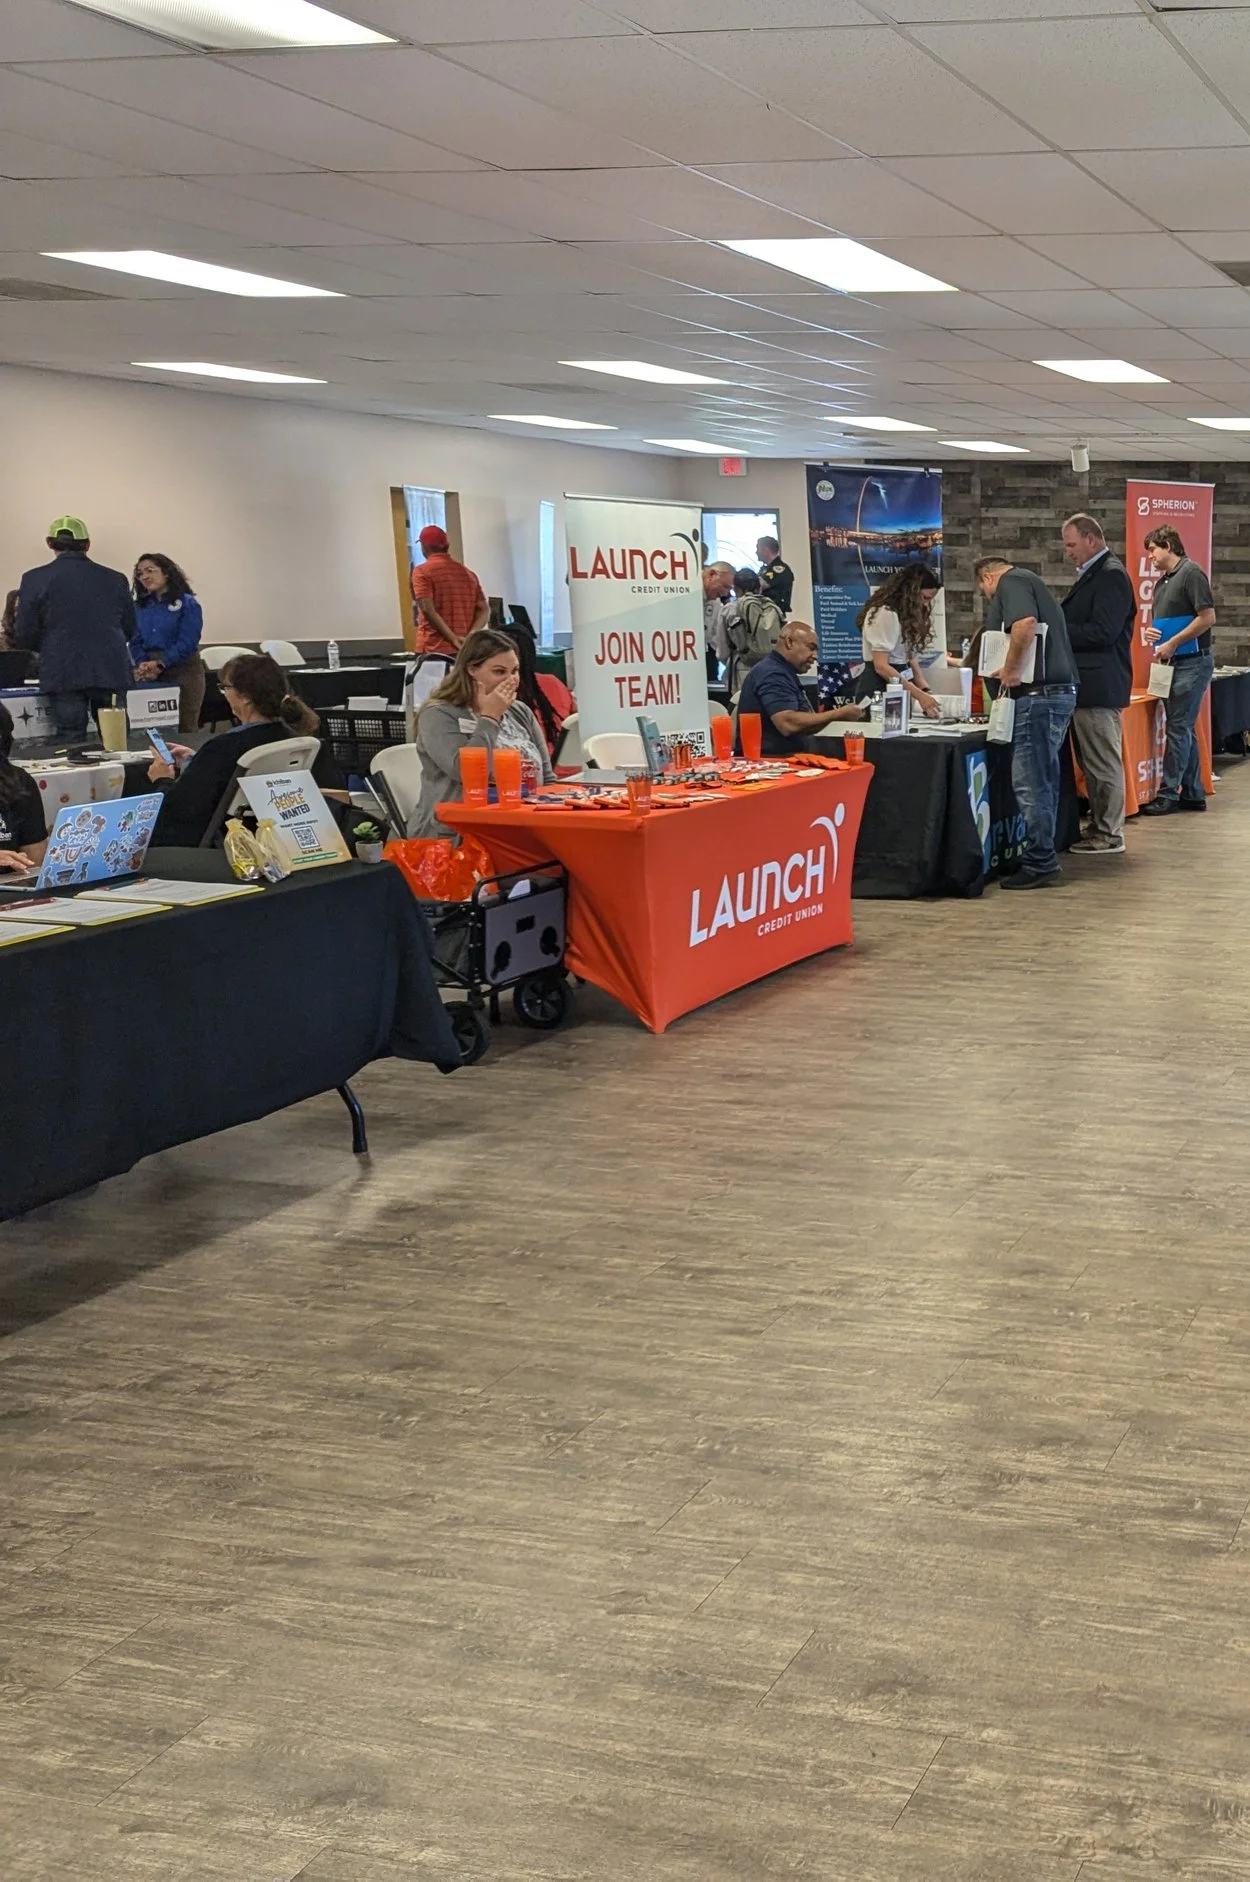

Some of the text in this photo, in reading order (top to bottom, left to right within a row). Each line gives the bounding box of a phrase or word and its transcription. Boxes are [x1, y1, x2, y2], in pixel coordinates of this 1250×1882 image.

[1152, 499, 1195, 510] SPHERION
[570, 545, 689, 581] LAUNCH
[865, 565, 893, 574] LAUNCH
[631, 586, 690, 594] CREDIT UNION
[594, 630, 698, 666] JOIN OUR
[614, 673, 682, 709] TEAM!
[274, 794, 306, 812] PEOPLE
[279, 803, 311, 821] WANTED
[689, 845, 826, 948] LAUNCH
[757, 903, 824, 937] CREDIT UNION
